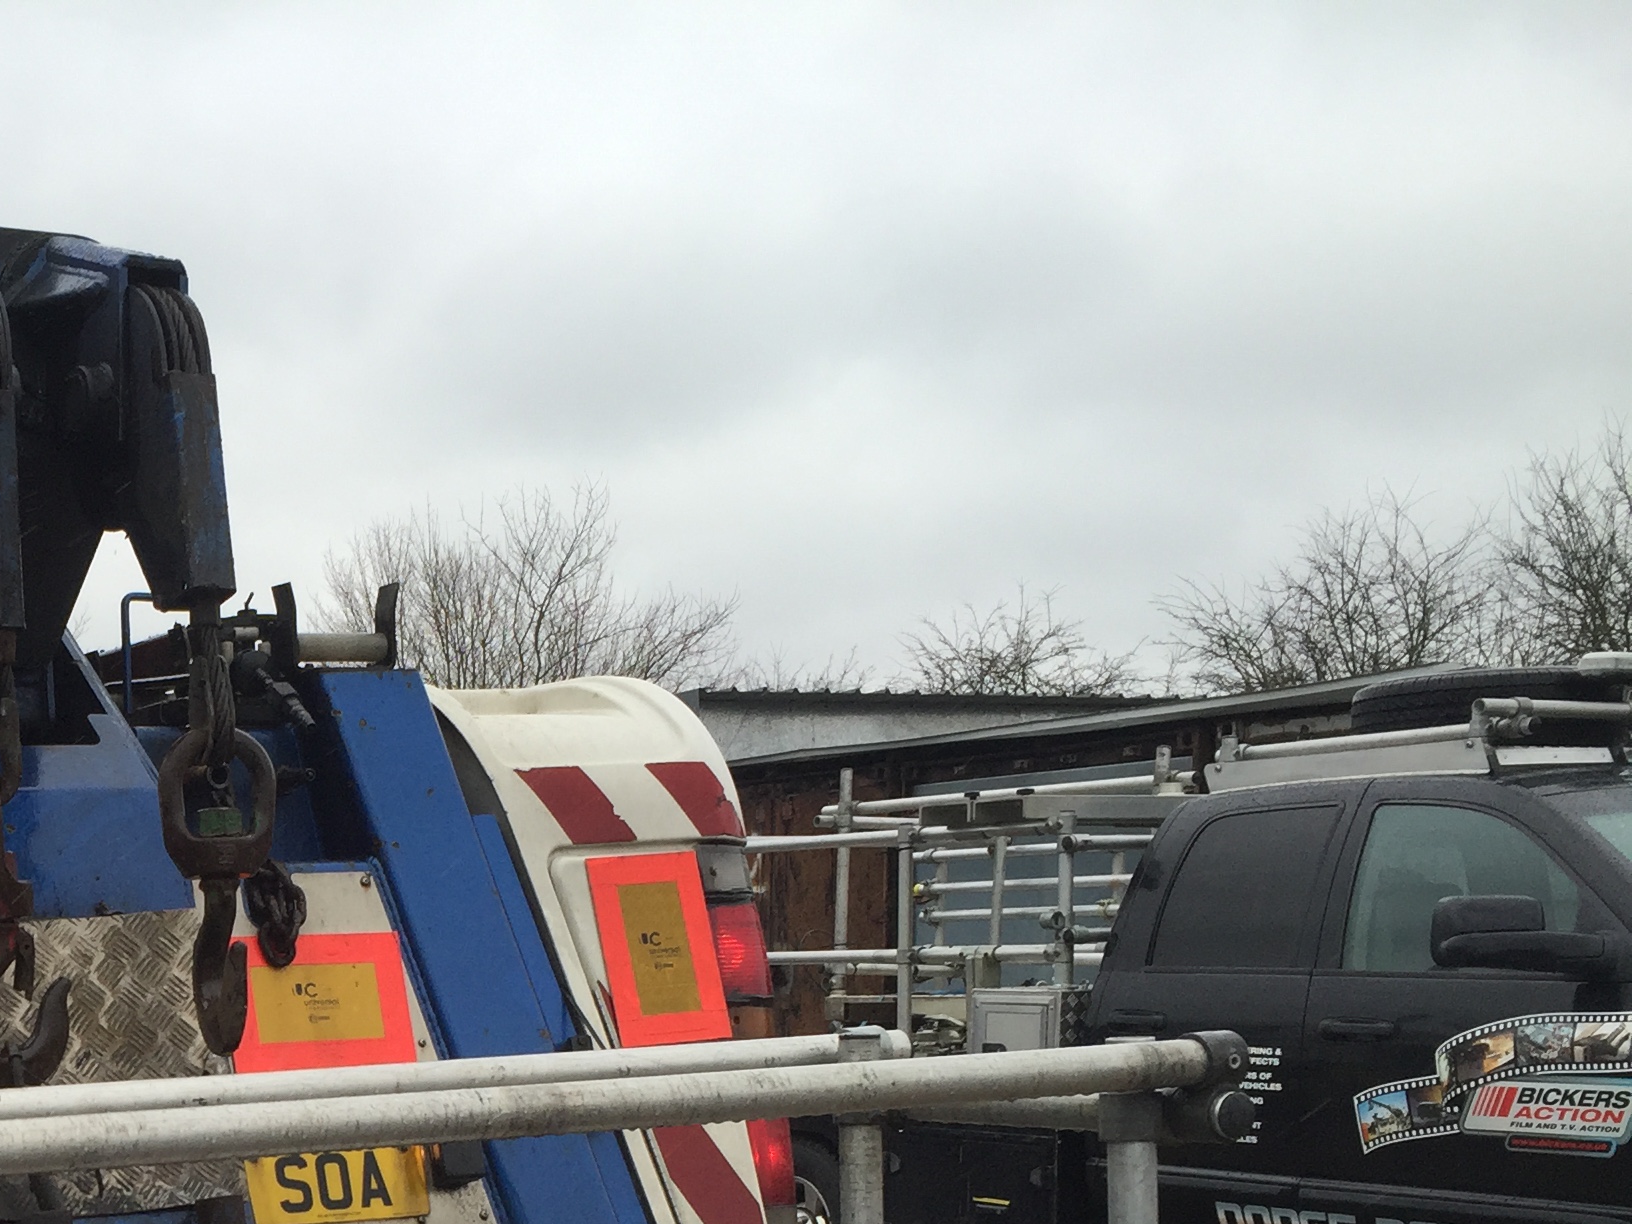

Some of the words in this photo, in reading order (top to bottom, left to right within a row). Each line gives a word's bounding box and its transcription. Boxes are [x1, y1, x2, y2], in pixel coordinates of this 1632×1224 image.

[1259, 1072, 1272, 1081] OF
[1516, 1087, 1632, 1109] BICKERS
[1513, 1106, 1625, 1124] ACTION
[1509, 1121, 1534, 1129] FILM
[1536, 1122, 1558, 1130] AND
[1579, 1126, 1621, 1134] ACTION
[274, 1150, 393, 1214] SOA
